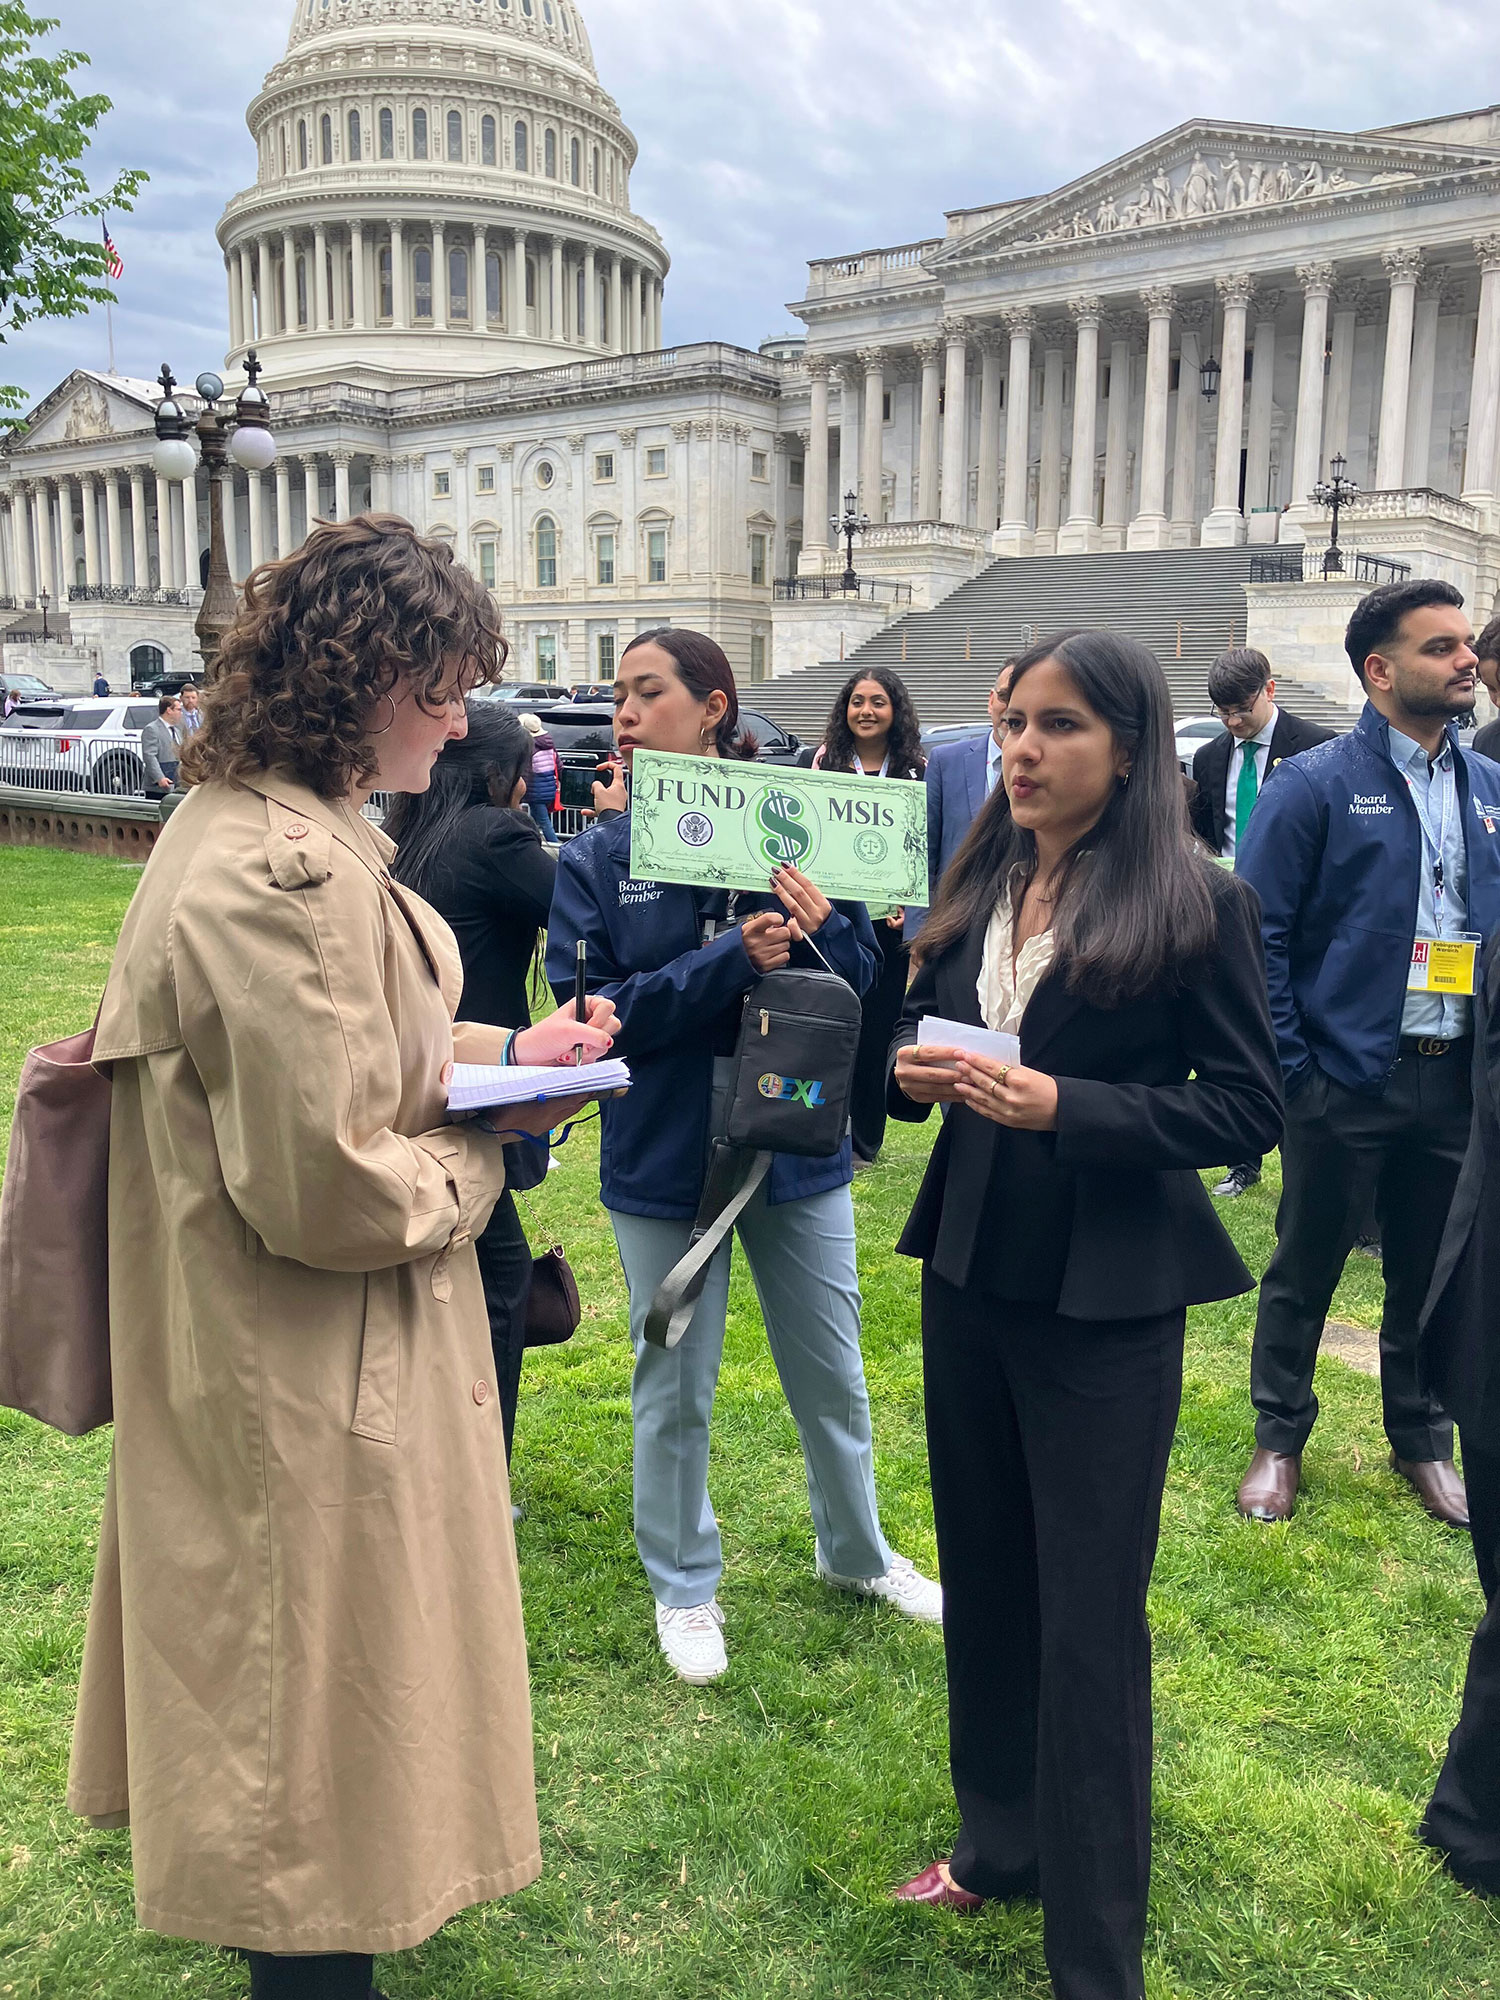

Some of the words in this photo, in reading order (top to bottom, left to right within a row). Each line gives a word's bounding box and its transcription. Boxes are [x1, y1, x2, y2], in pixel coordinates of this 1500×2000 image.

[656, 778, 746, 810] FUND
[828, 797, 895, 828] MSIs
[1353, 793, 1387, 804] Board
[1348, 803, 1394, 815] Member
